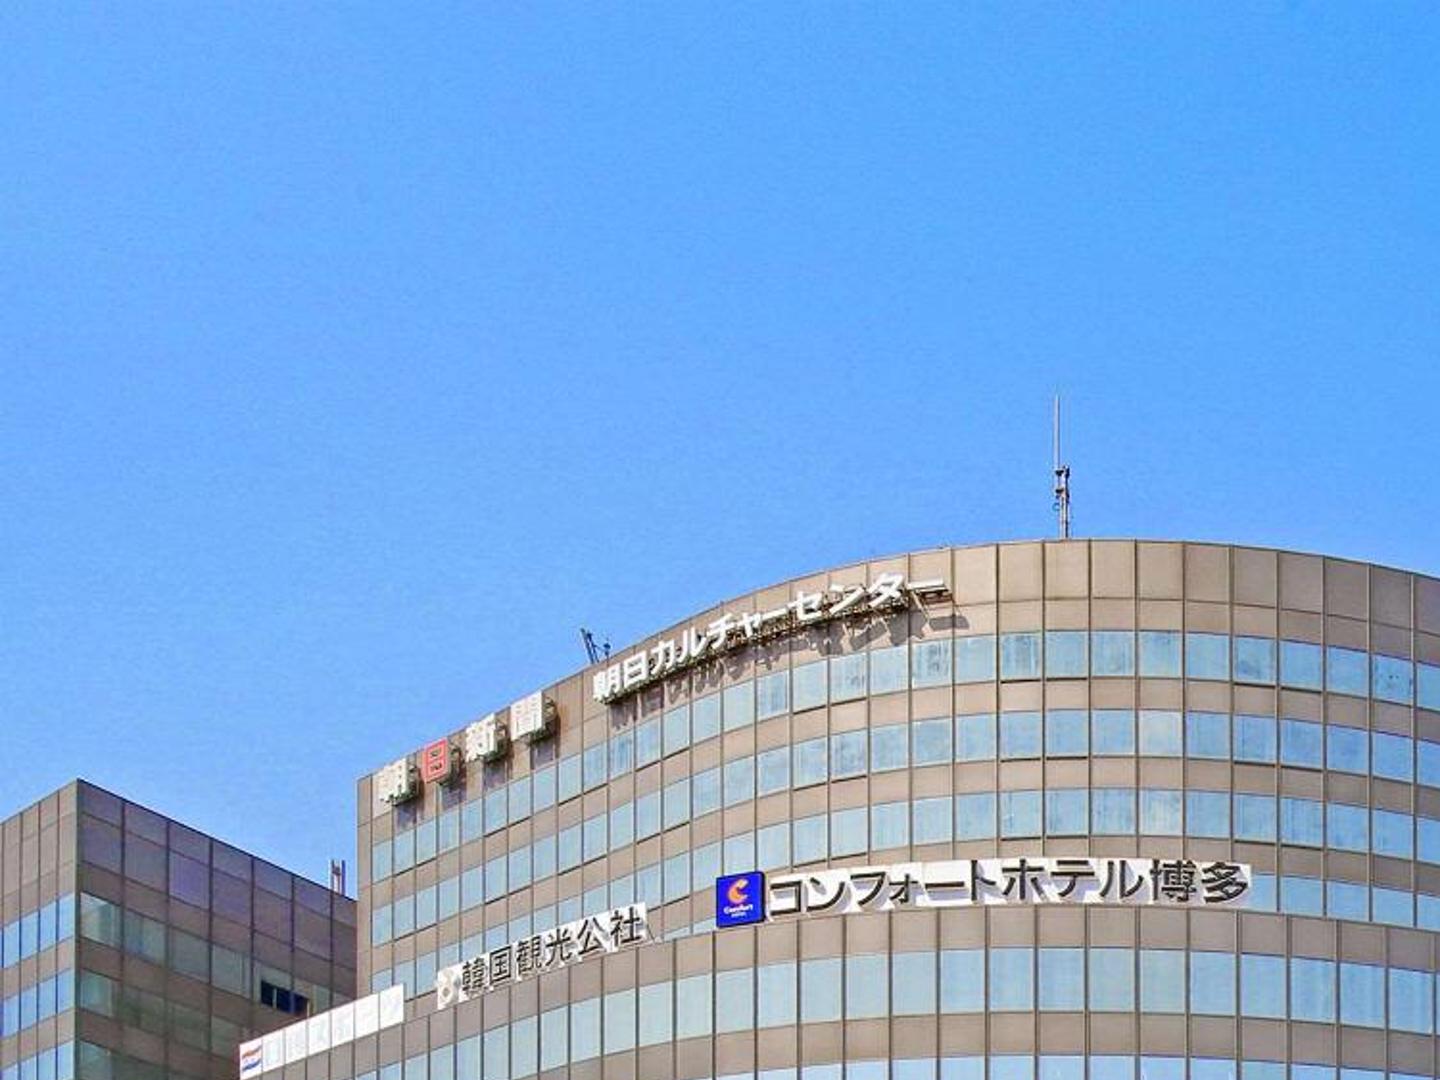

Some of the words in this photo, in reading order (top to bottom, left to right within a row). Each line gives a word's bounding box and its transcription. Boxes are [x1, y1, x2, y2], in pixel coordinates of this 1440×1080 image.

[593, 572, 948, 702] 朝日カルチャーセンター
[769, 859, 1248, 915] コンフォートホテル博多
[461, 906, 642, 991] 韓国観光公社
